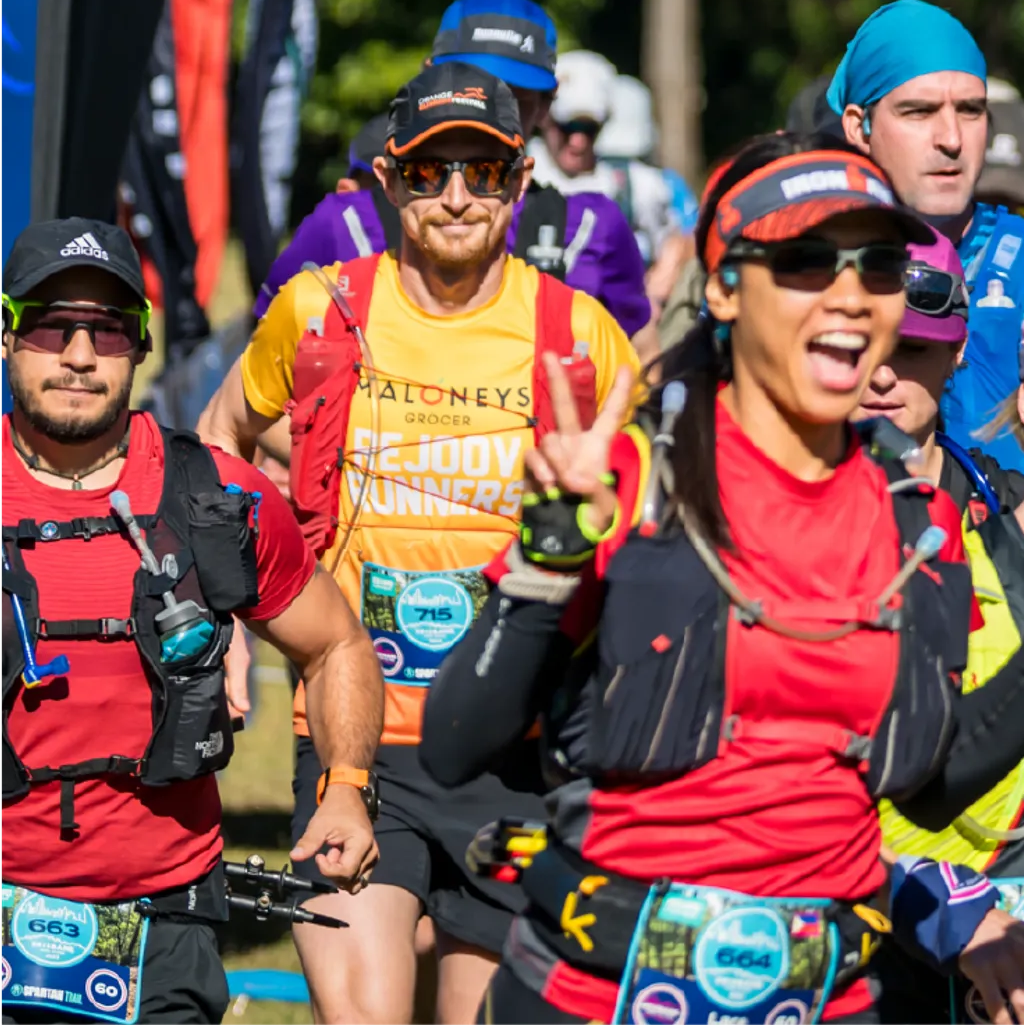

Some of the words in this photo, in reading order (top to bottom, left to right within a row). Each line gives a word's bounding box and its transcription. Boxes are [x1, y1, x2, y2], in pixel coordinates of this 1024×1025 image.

[60, 247, 109, 261] adidas
[353, 379, 531, 408] MALONEYS
[405, 412, 472, 426] GROCER
[413, 606, 453, 622] 715
[28, 918, 81, 938] 663
[716, 947, 772, 969] 664
[94, 982, 119, 998] 60
